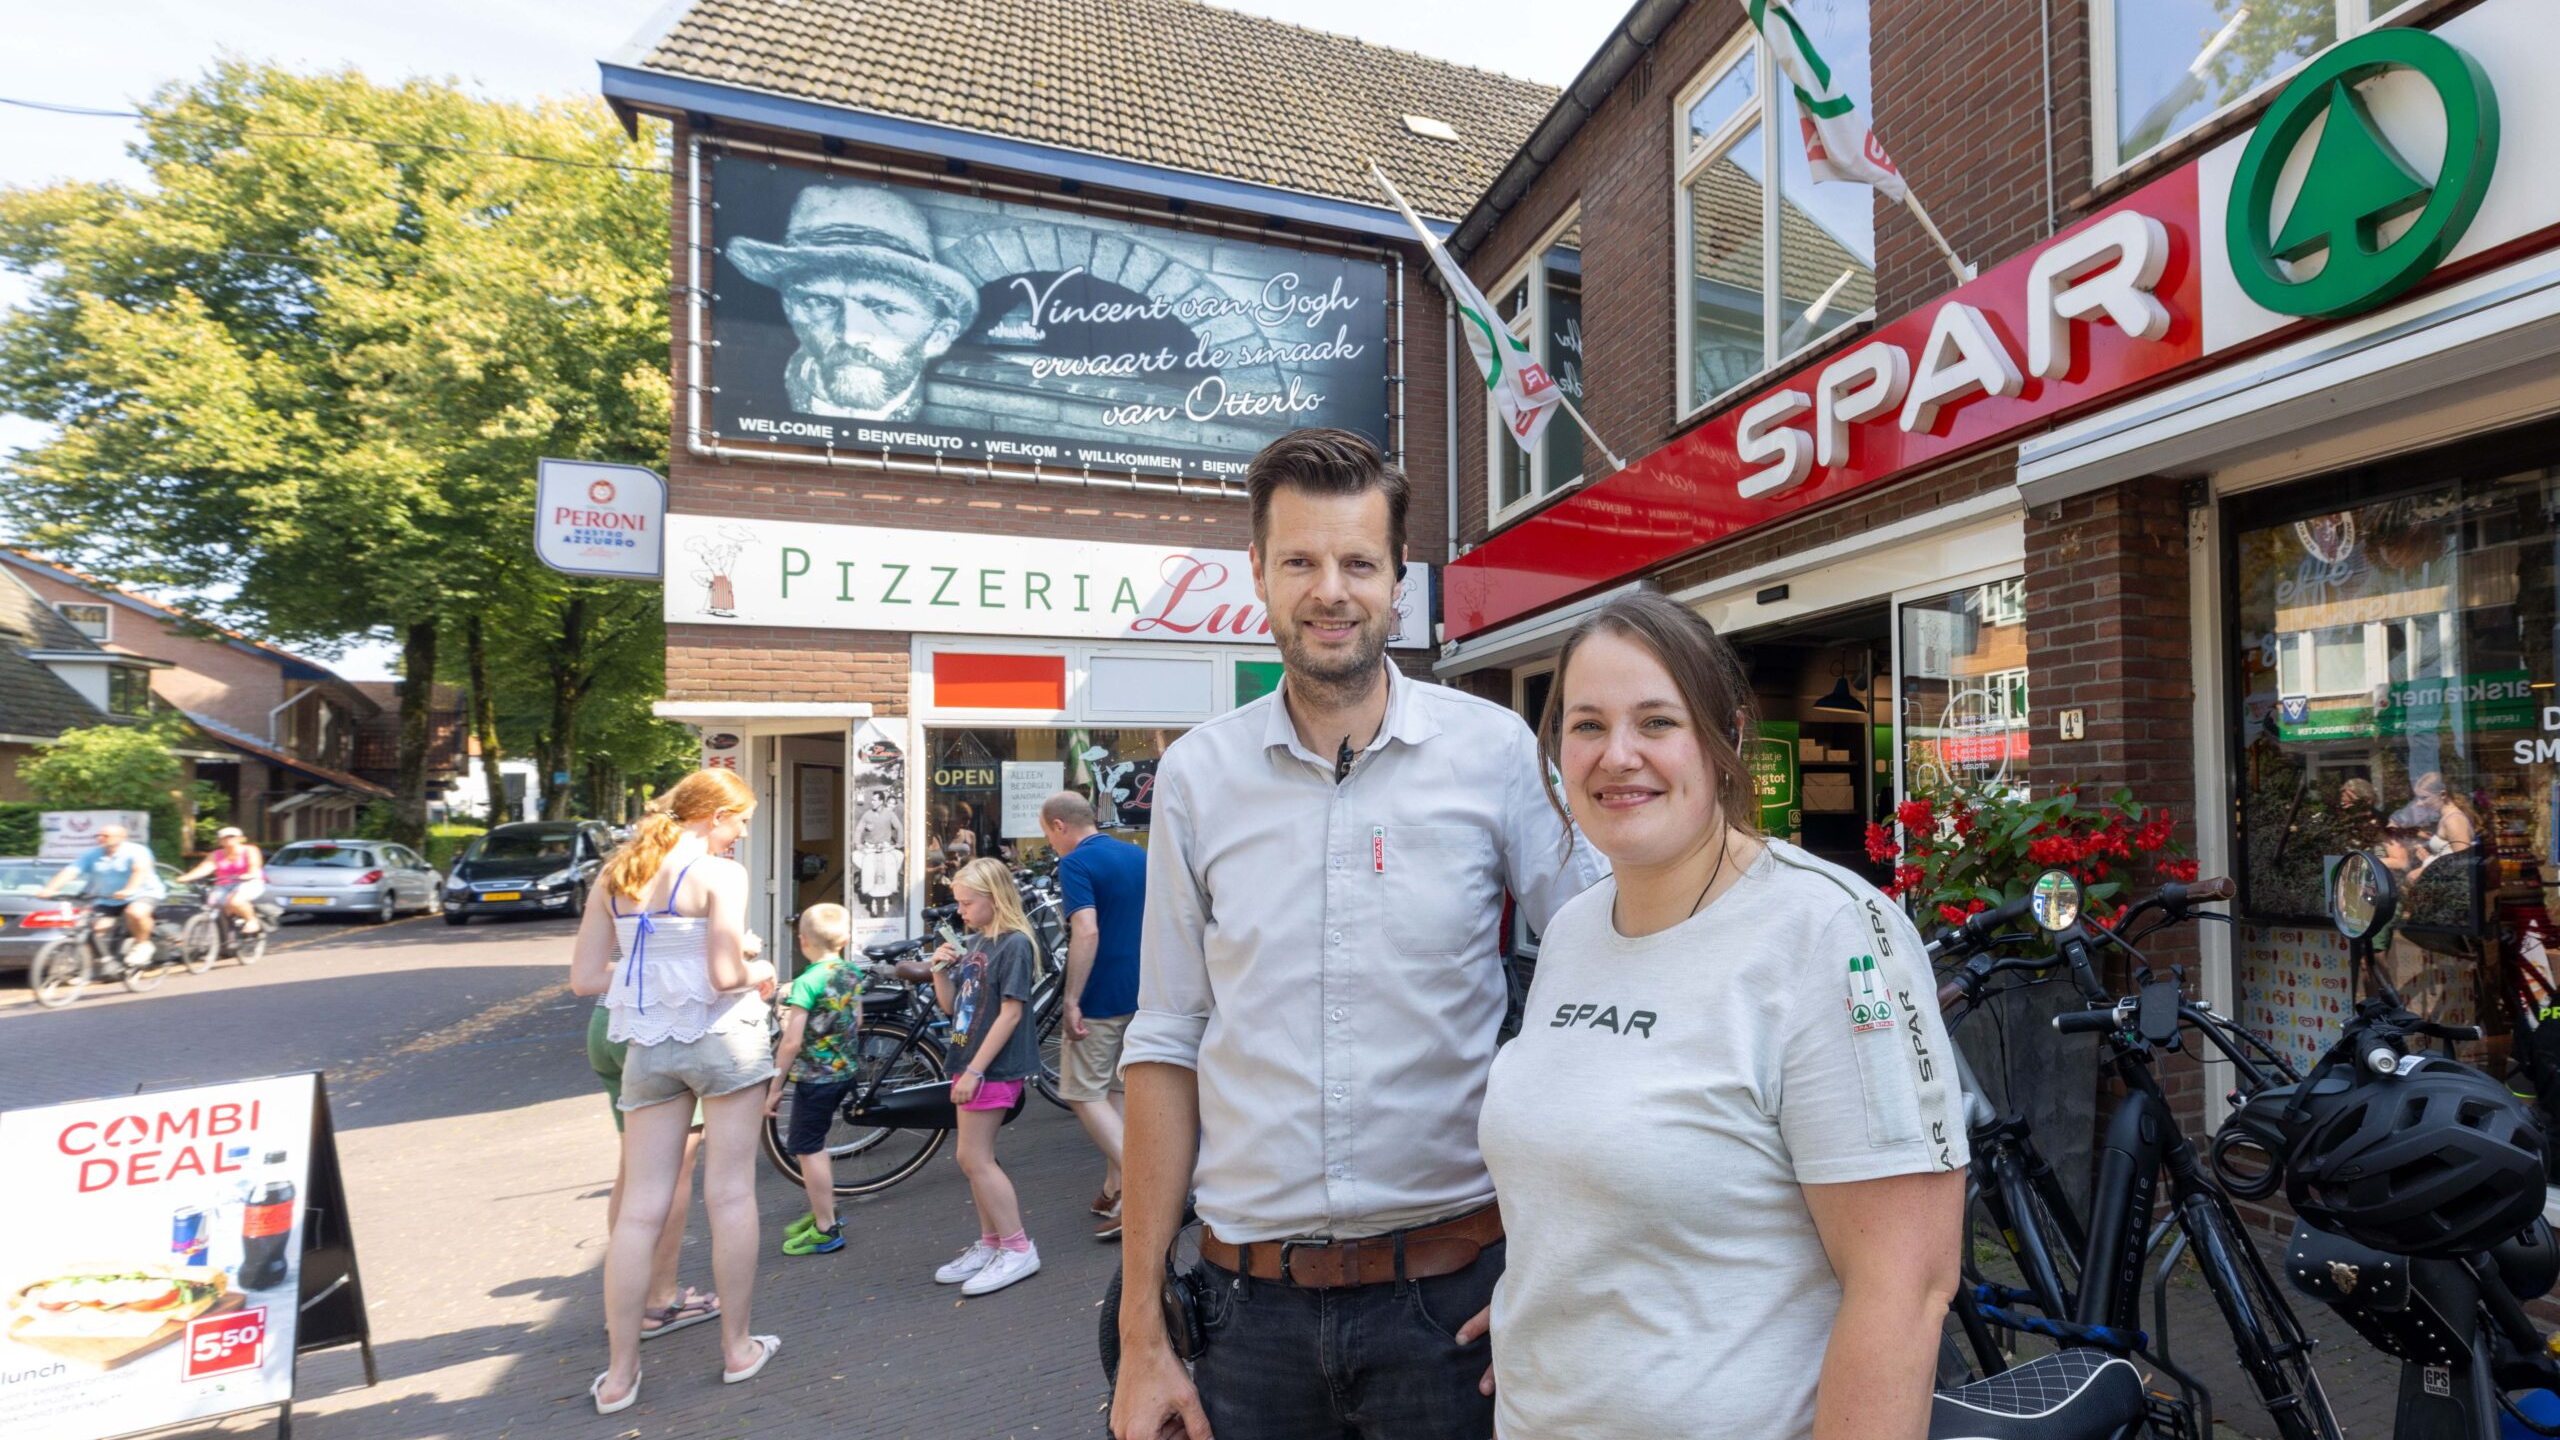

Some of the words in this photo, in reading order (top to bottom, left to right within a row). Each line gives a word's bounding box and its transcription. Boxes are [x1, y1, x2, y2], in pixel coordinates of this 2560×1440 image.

[1010, 266, 1175, 326] Vincent
[1180, 296, 1251, 317] van
[1254, 272, 1360, 328] Gogh
[1031, 346, 1179, 379] ervaart
[1184, 331, 1233, 368] de
[1238, 325, 1364, 365] smaak
[1736, 209, 2171, 501] SPAR
[1102, 404, 1177, 428] van
[1184, 375, 1327, 422] Otterlo
[738, 417, 834, 438] WELCOME
[858, 429, 963, 449] BENVENUTO
[985, 440, 1057, 458] WELKOM
[1078, 449, 1182, 469] WILLKOMMEN
[555, 507, 645, 531] PERONI
[563, 535, 635, 548] AZZURRO
[780, 547, 1140, 614] PIZZERIA
[934, 769, 994, 786] OPEN
[1010, 770, 1044, 780] ALLEEN
[1010, 781, 1053, 791] BEZORGEN
[1770, 773, 1785, 783] tot
[1375, 837, 1384, 864] SPAR
[1865, 897, 1893, 958] SPA
[1550, 1003, 1658, 1039] SPAR
[1898, 989, 1935, 1084] SPAR
[58, 1100, 260, 1156] COMBI
[1932, 1118, 1956, 1172] AR
[78, 1142, 243, 1193] DEAL
[2124, 1177, 2149, 1282] Gazelle
[1, 1362, 67, 1385] lunch
[2425, 1370, 2449, 1387] GPS
